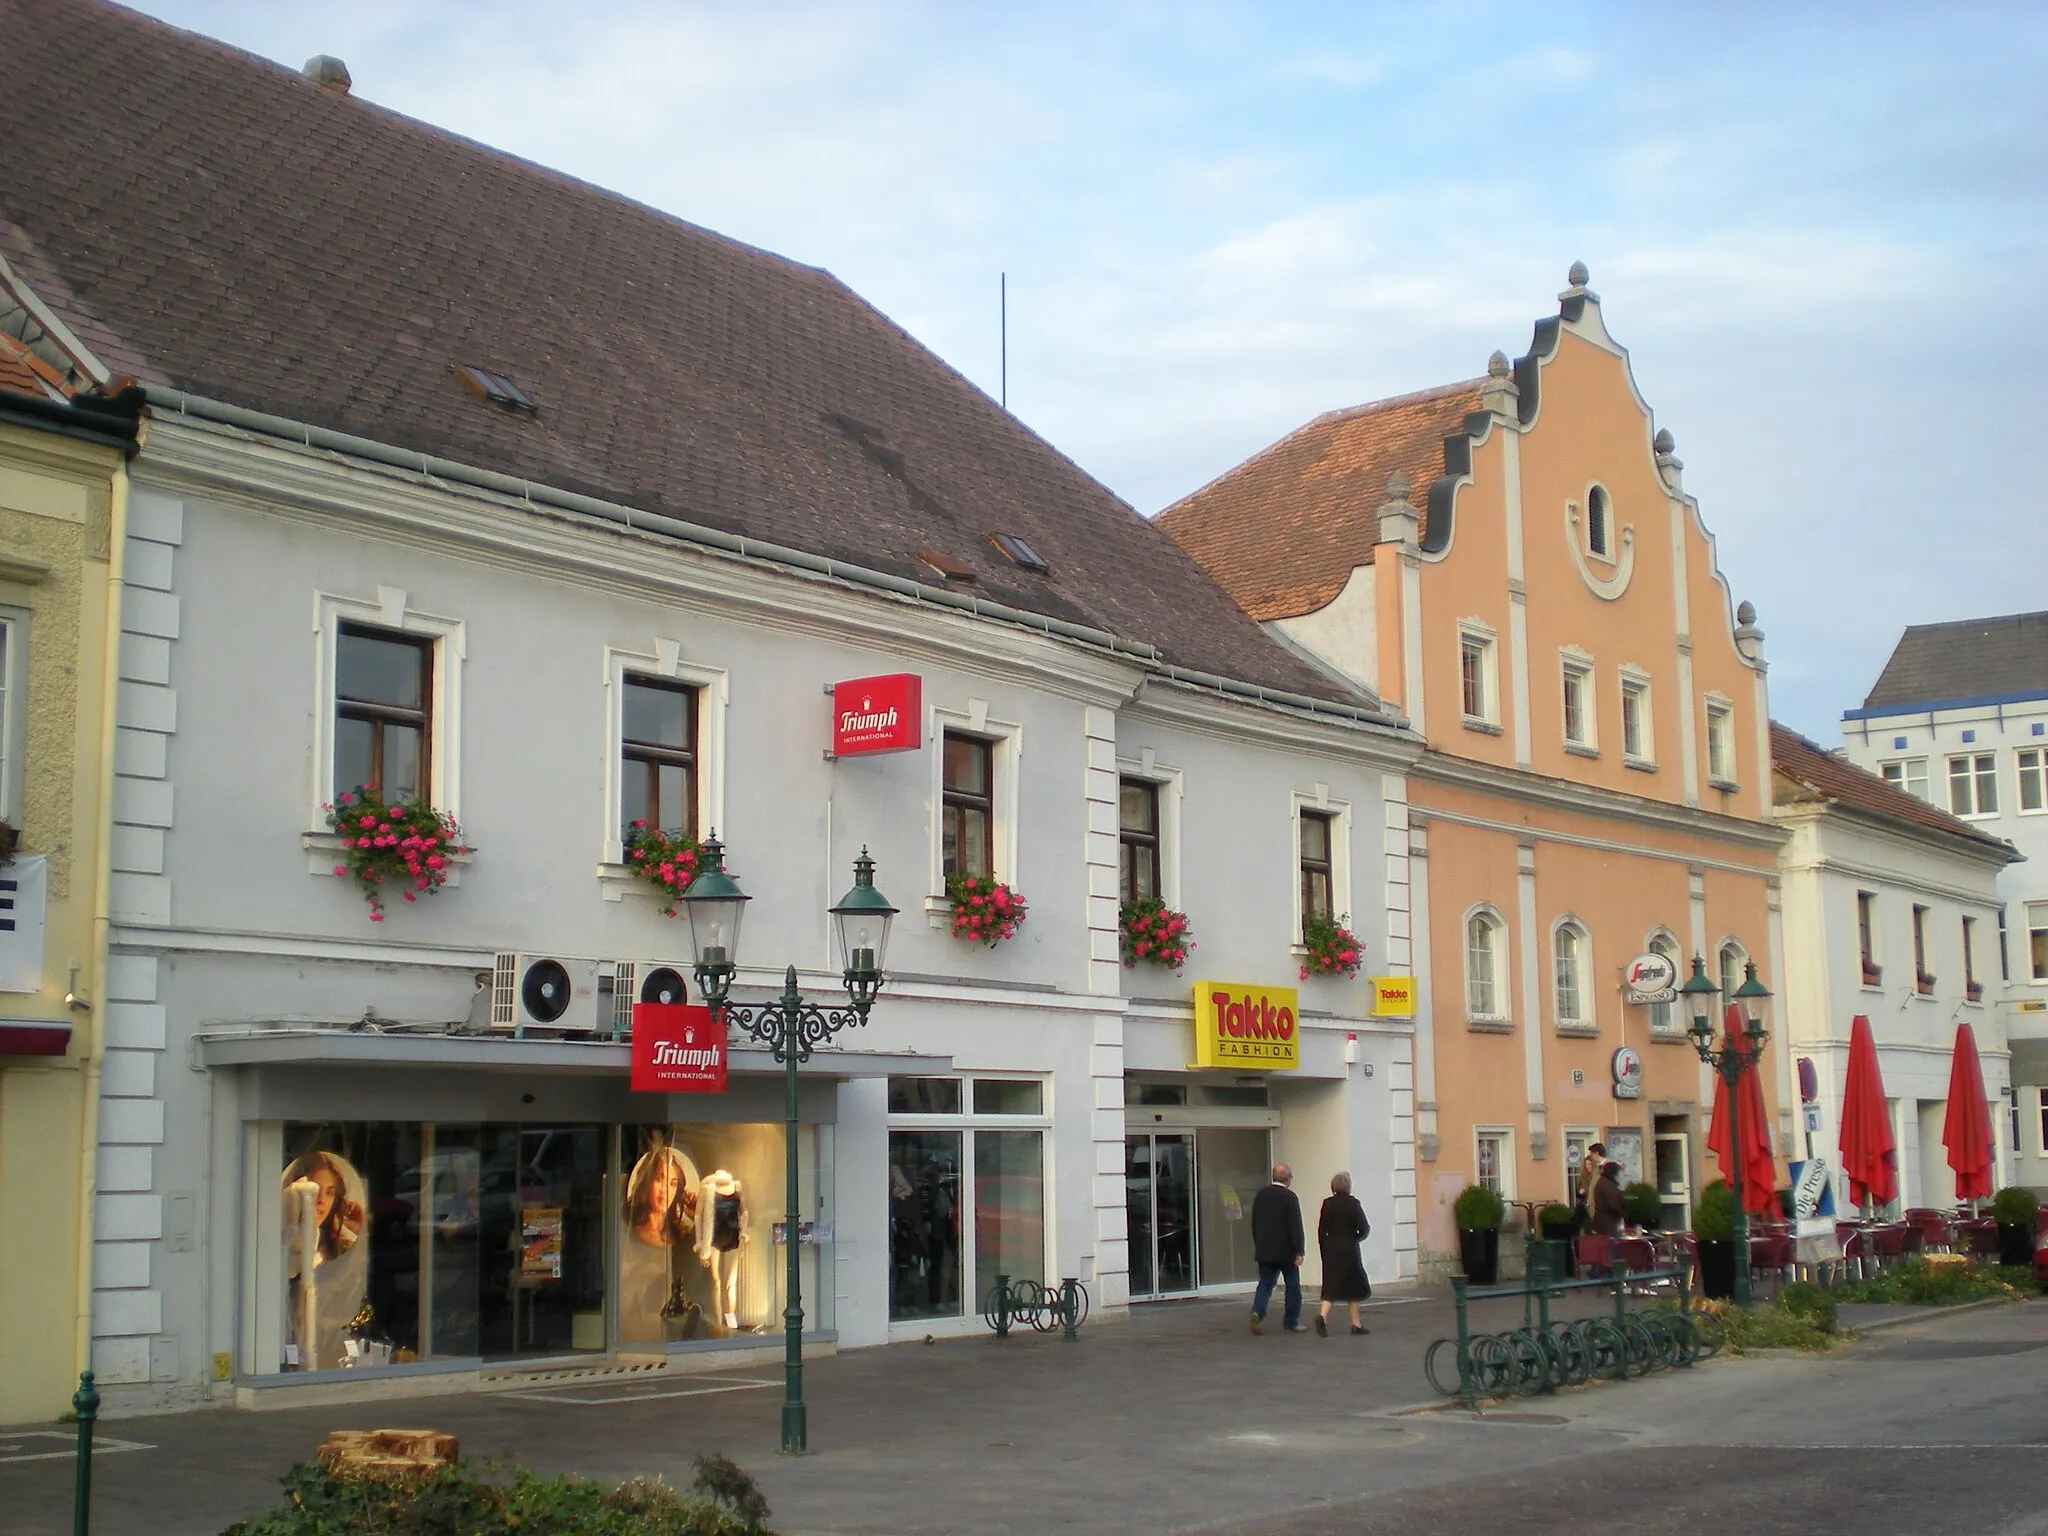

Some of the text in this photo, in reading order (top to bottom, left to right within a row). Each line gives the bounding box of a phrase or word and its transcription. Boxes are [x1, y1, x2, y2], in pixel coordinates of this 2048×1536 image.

[840, 706, 898, 733] Triumph
[843, 732, 894, 743] INTERNATIONAL
[1380, 989, 1408, 999] Takko
[1211, 992, 1294, 1041] Takko
[652, 1040, 720, 1071] Triumph
[1219, 1043, 1292, 1056] FASHION
[657, 1072, 716, 1080] INTERNATIONAL
[1796, 1158, 1827, 1215] Die Presse
